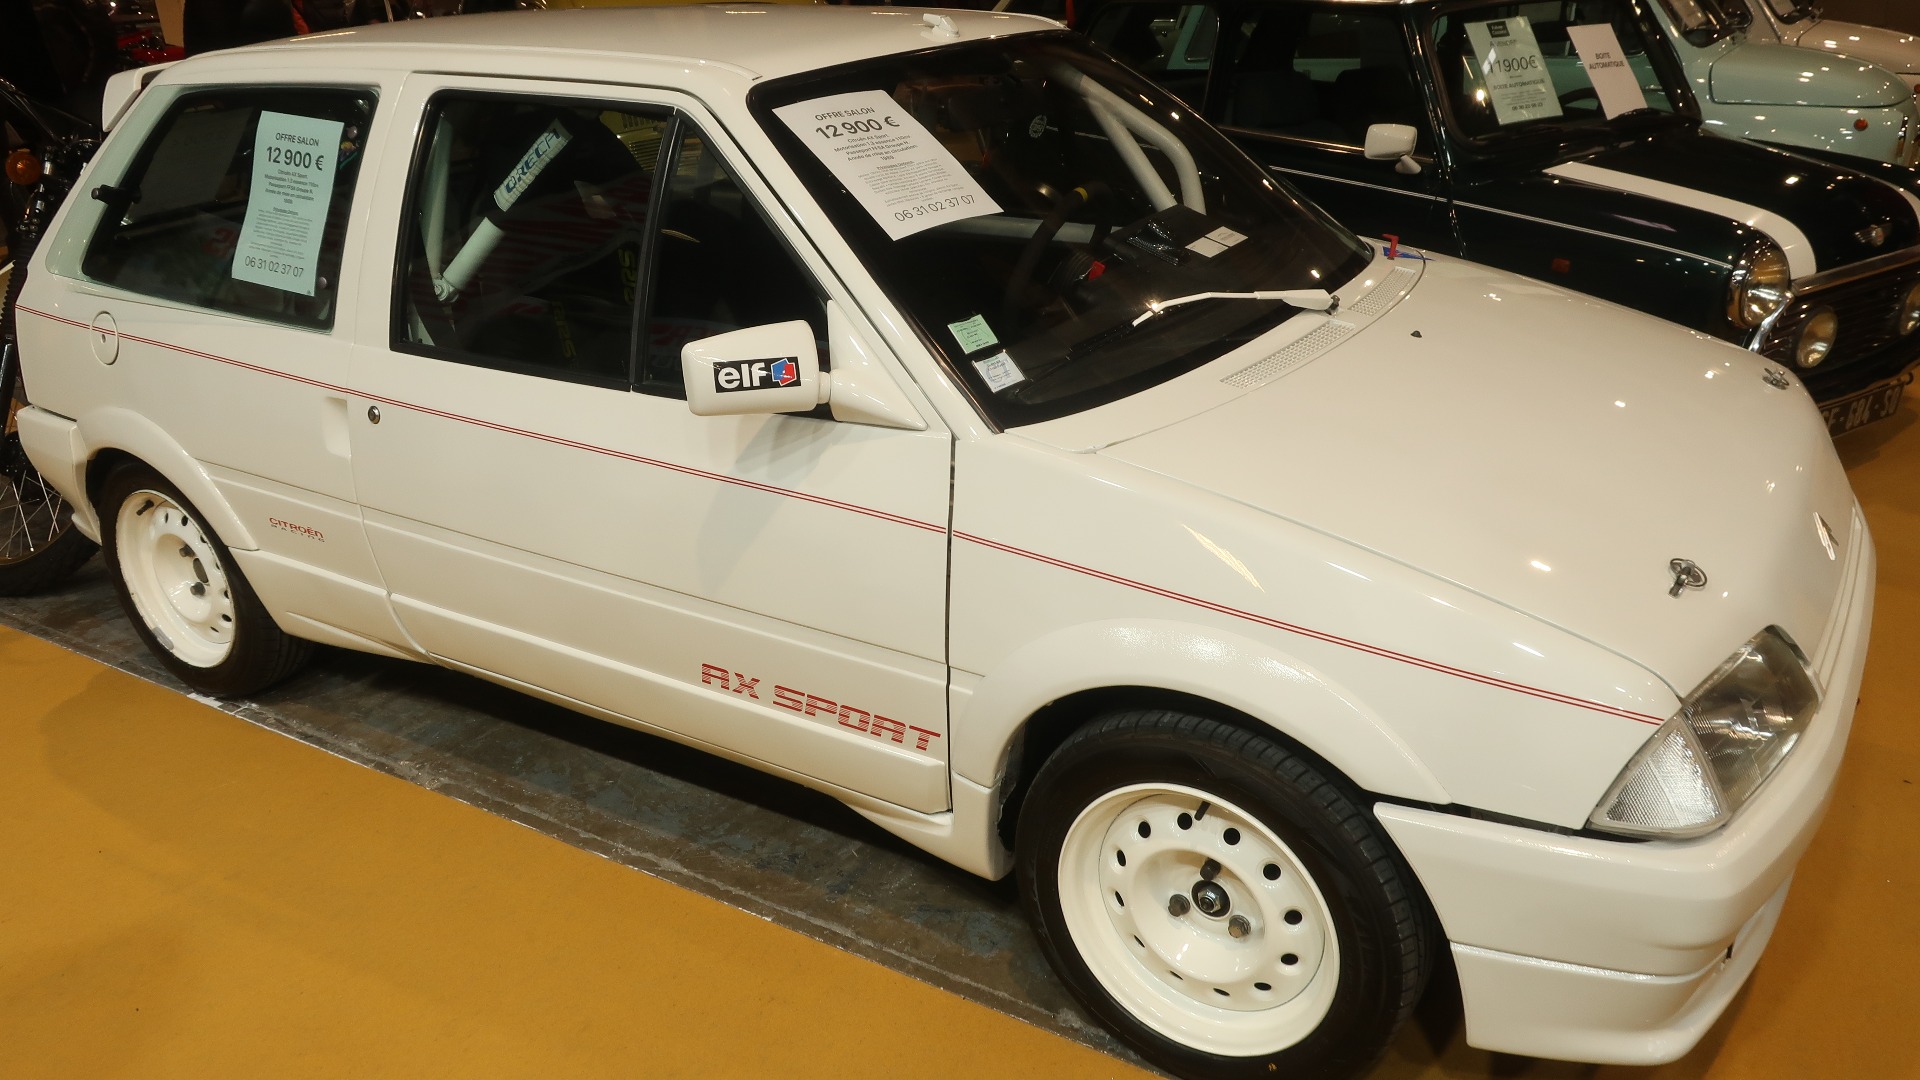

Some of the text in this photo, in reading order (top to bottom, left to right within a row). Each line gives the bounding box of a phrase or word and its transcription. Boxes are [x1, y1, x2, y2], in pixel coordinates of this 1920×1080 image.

[1589, 60, 1625, 70] AUTOMATIQUE
[1595, 52, 1611, 60] BOITE
[815, 107, 876, 121] OFFRE SALON
[815, 115, 900, 139] 12 900 €
[275, 132, 320, 147] OFFRE SALON
[266, 146, 324, 171] 12 900 €
[505, 128, 561, 194] ORECA
[894, 193, 976, 223] 06 31 02 37 07
[244, 255, 305, 279] 06 31 02 37 07
[717, 362, 767, 389] elf
[700, 662, 761, 700] AX
[772, 684, 942, 752] SPORT
